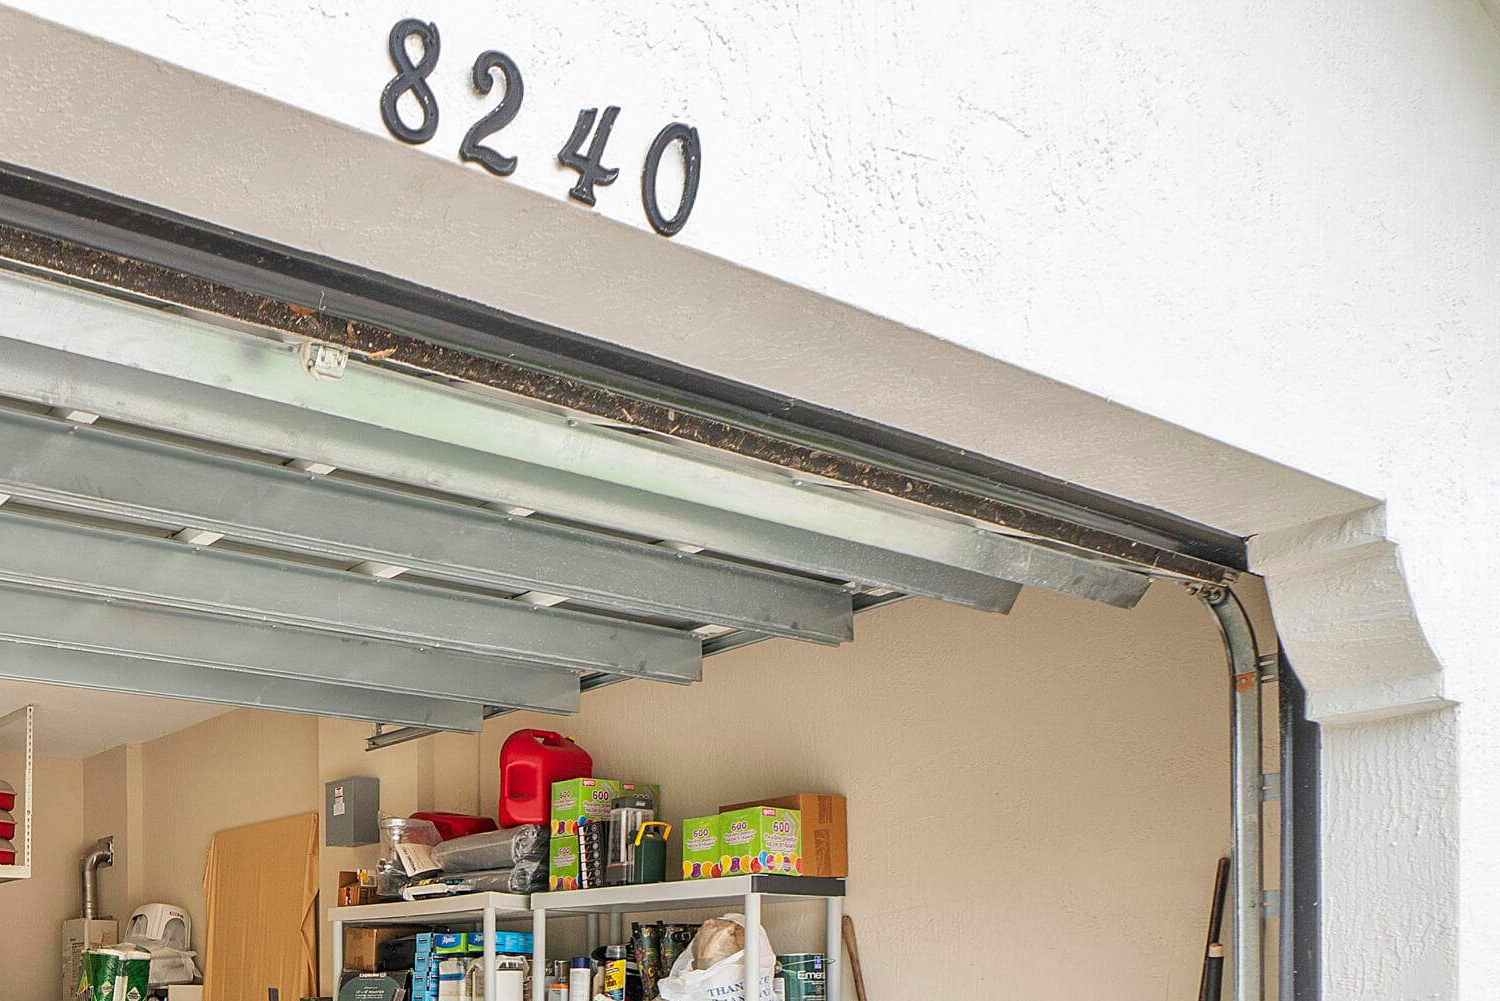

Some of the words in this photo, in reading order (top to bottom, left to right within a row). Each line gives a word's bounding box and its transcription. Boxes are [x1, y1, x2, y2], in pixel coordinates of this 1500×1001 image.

[380, 18, 701, 237] 8240
[592, 790, 610, 801] 600
[731, 821, 747, 832] 600
[773, 821, 790, 833] 600
[693, 828, 709, 838] 600
